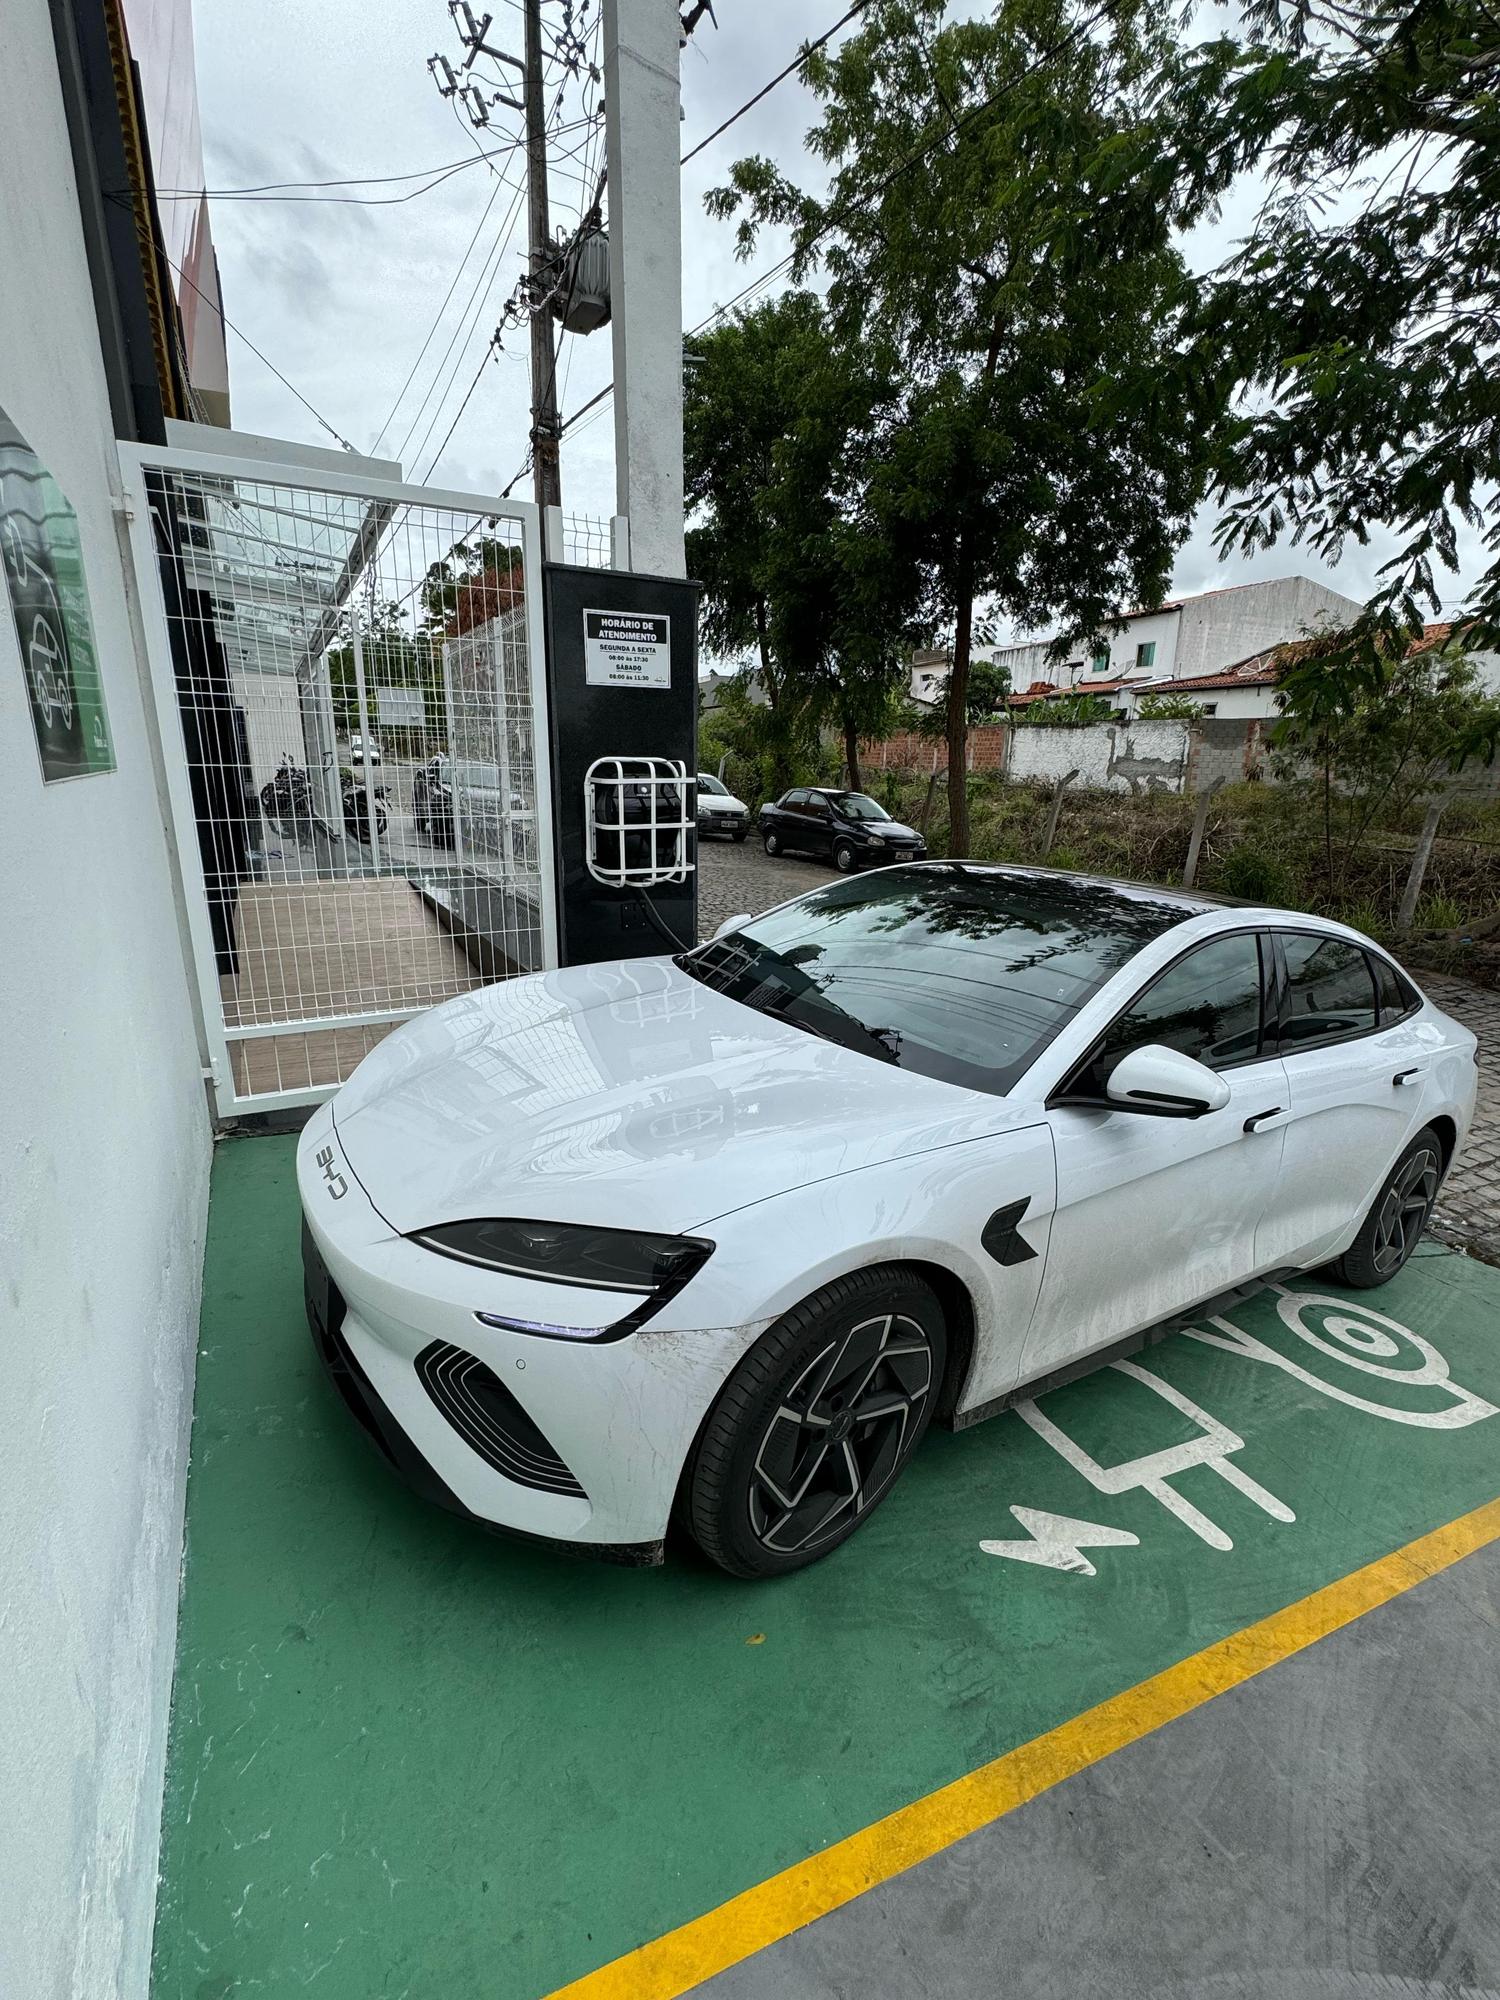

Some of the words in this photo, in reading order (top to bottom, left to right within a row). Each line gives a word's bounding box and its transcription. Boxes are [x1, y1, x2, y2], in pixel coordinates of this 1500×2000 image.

[601, 618, 640, 629] HORÁRIO
[642, 622, 654, 630] DE
[599, 630, 657, 641] ATENDIMENTO
[600, 644, 630, 652] SEGUNDA
[616, 663, 642, 671] SÁBADO
[316, 1145, 348, 1200] BYD
